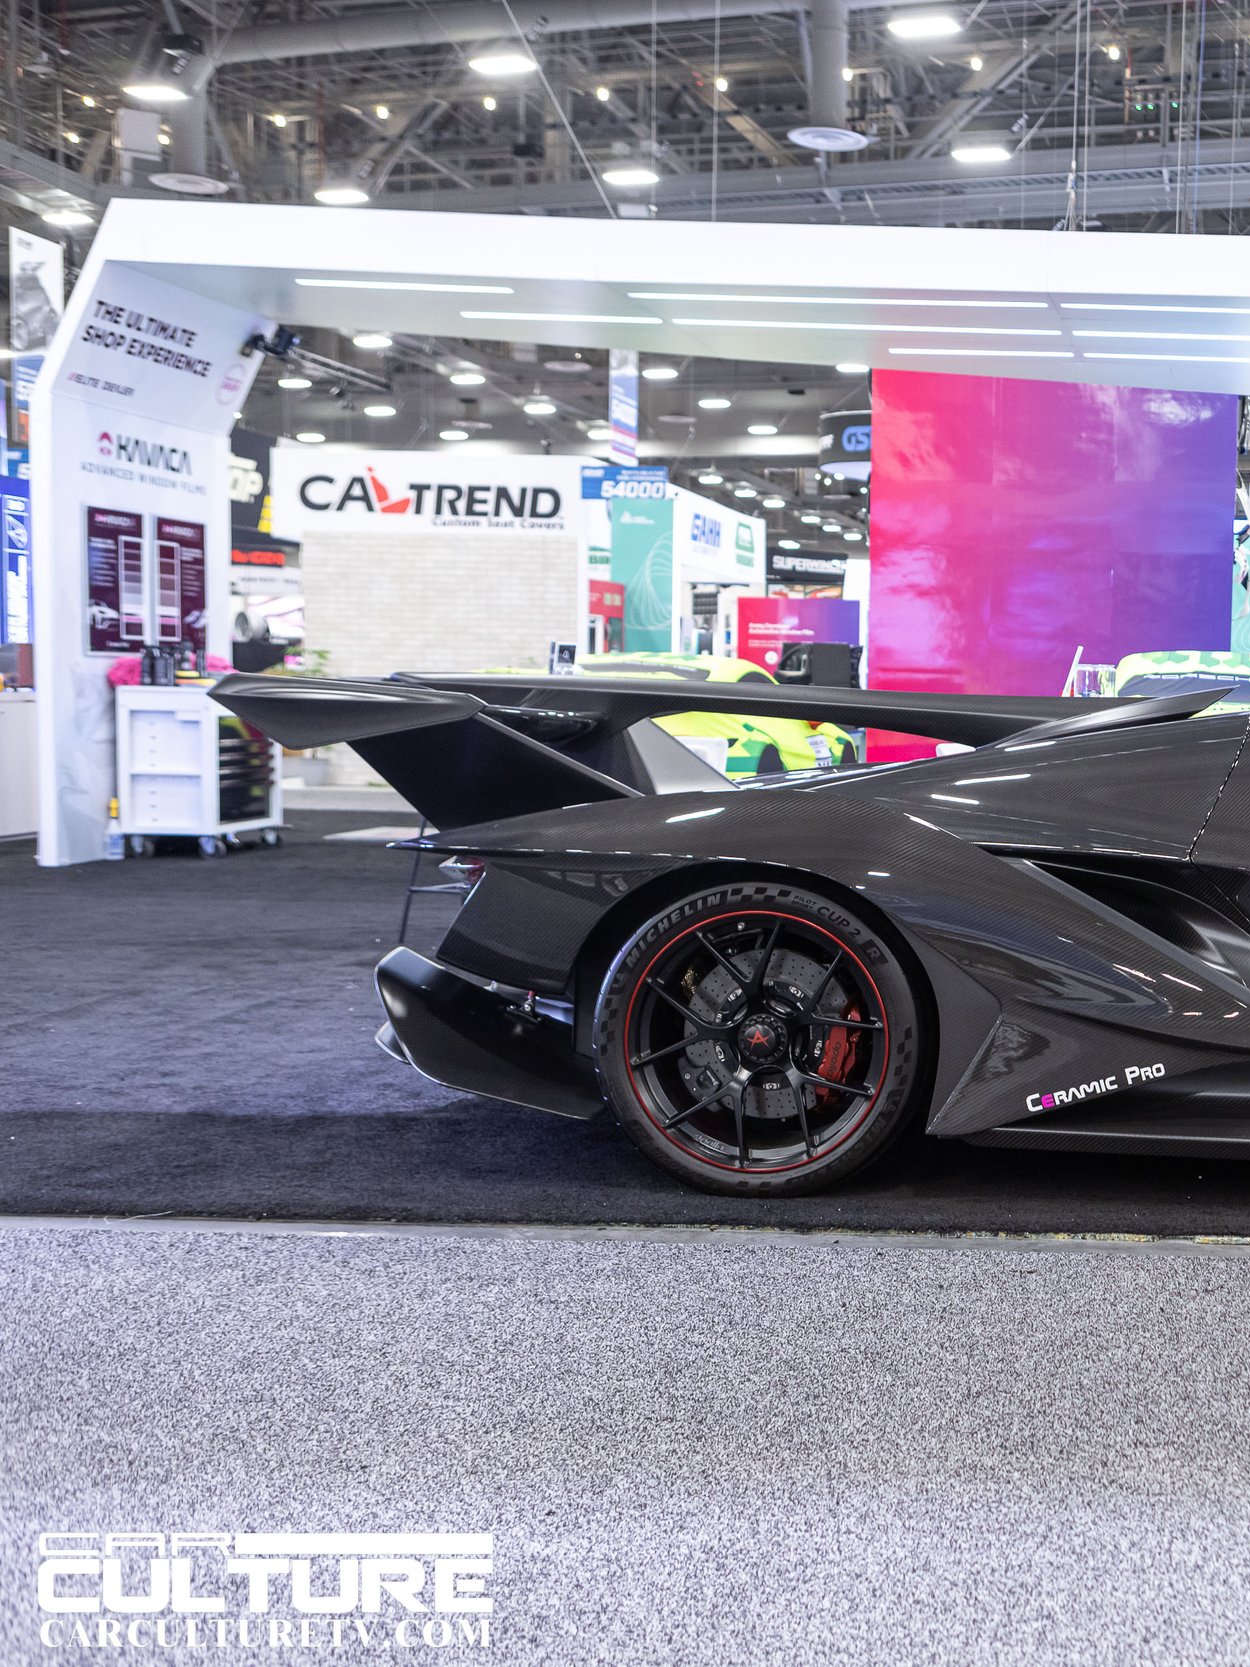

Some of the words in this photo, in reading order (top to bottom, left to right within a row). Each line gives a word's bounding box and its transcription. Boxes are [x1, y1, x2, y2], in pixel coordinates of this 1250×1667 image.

[93, 299, 124, 324] THE
[125, 310, 197, 347] ULTIMATE
[81, 325, 127, 352] SHOP
[126, 337, 213, 378] EXPERIENCE
[601, 480, 665, 498] 54000
[432, 517, 481, 528] Custom
[487, 518, 514, 529] Seat
[520, 519, 564, 530] Covers
[625, 893, 720, 968] MICHELIN
[817, 906, 850, 927] CUP
[848, 928, 860, 938] 2
